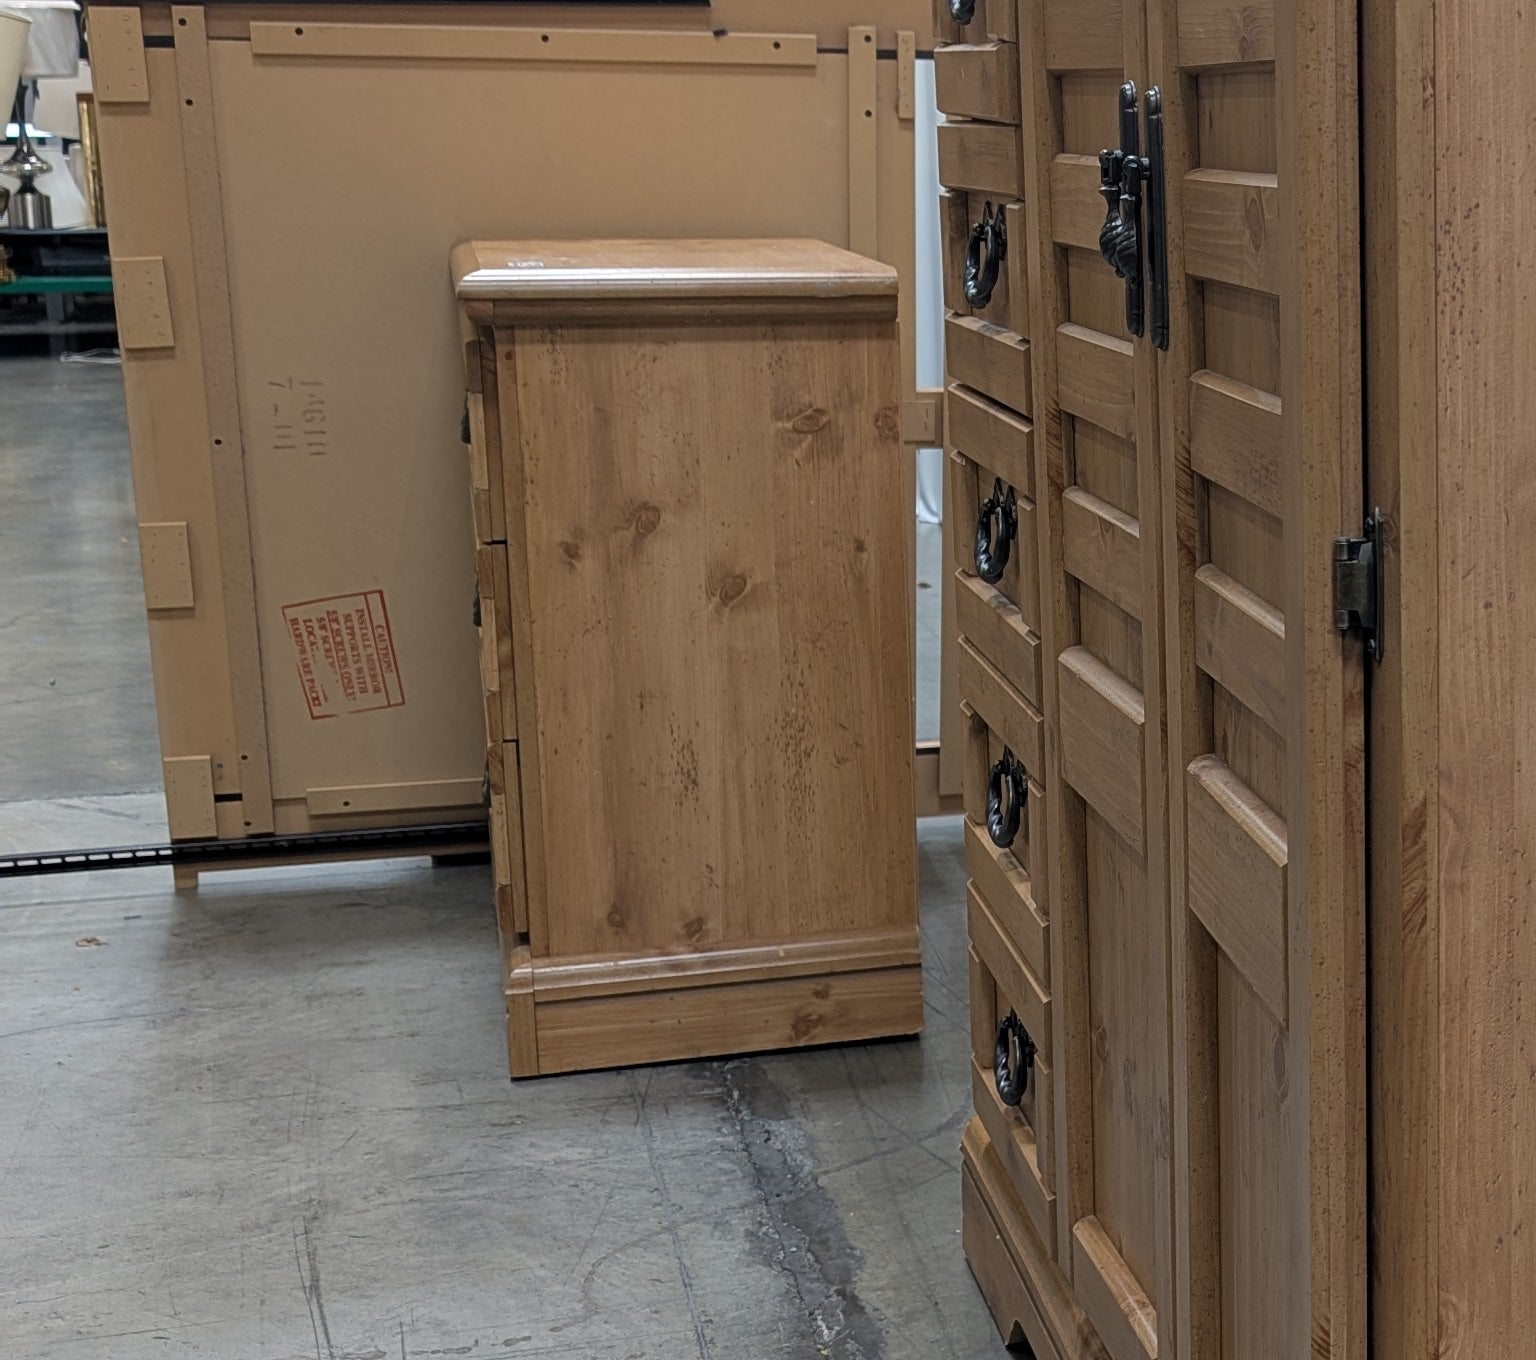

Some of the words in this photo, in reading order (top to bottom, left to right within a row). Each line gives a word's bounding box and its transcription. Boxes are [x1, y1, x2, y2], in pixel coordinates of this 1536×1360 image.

[342, 613, 361, 664] SUPPORTS
[354, 666, 368, 694] WITH
[355, 608, 372, 651] INSTALL
